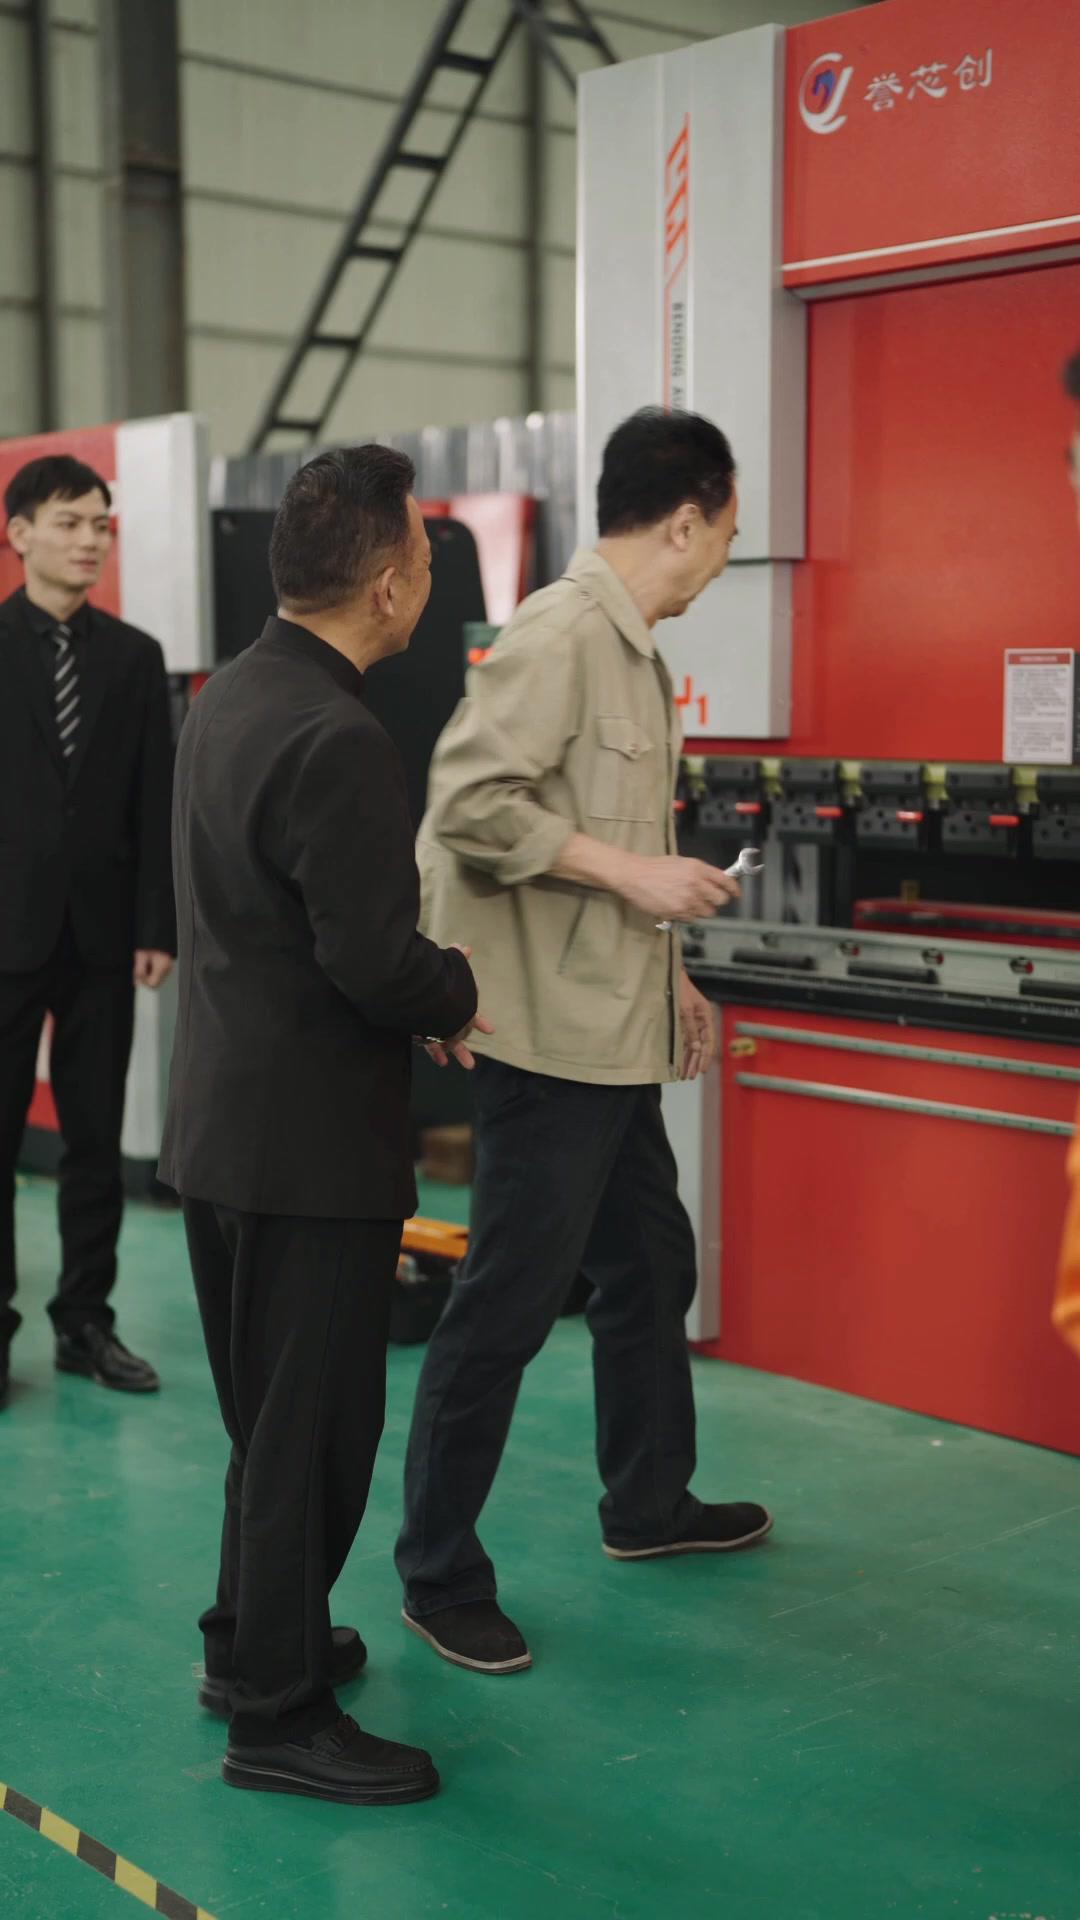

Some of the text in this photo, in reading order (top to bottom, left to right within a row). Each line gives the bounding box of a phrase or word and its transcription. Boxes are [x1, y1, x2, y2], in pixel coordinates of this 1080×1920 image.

[864, 48, 993, 112] 誉芯创
[671, 302, 685, 377] BENDING
